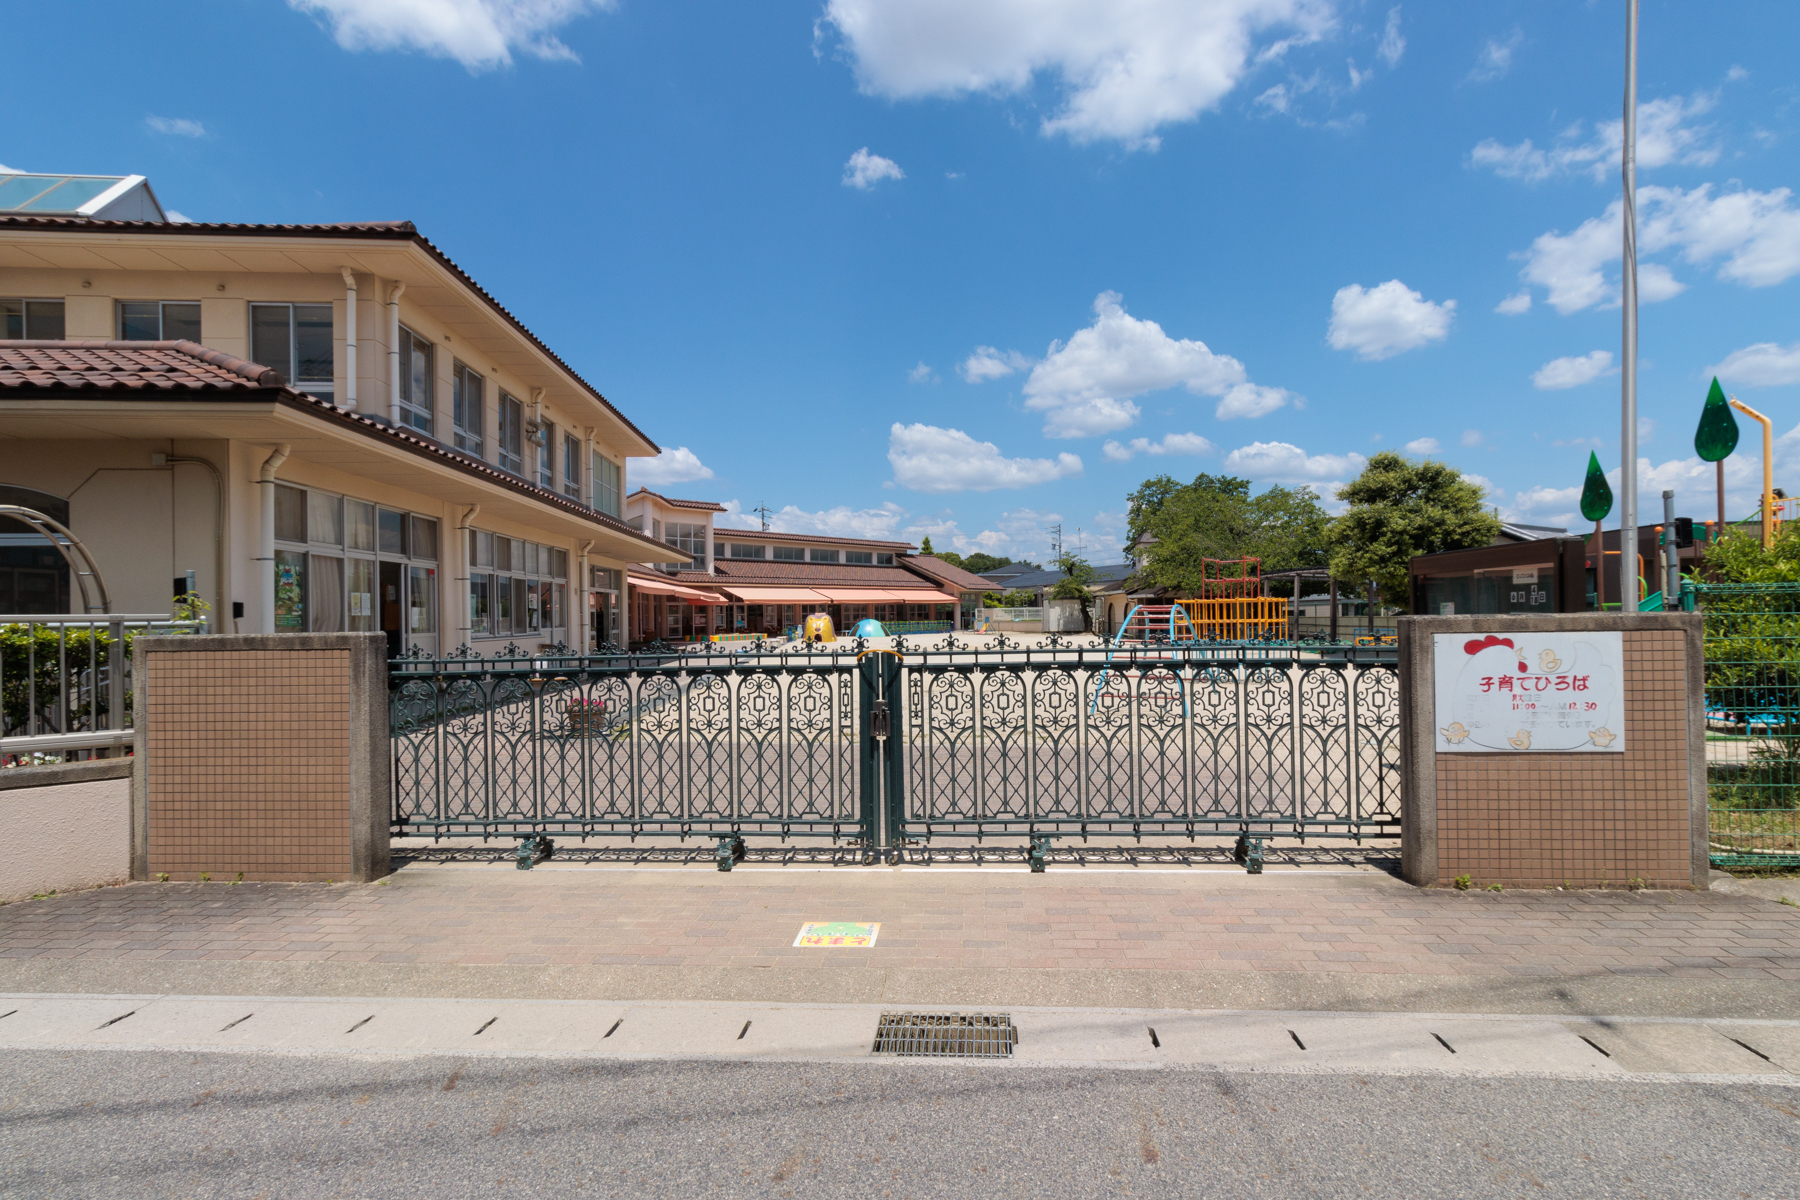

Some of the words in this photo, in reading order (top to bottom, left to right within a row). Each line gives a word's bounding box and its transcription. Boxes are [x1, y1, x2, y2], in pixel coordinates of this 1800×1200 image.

[1479, 675, 1590, 692] 子育てひろば
[805, 937, 868, 945] とまれ
